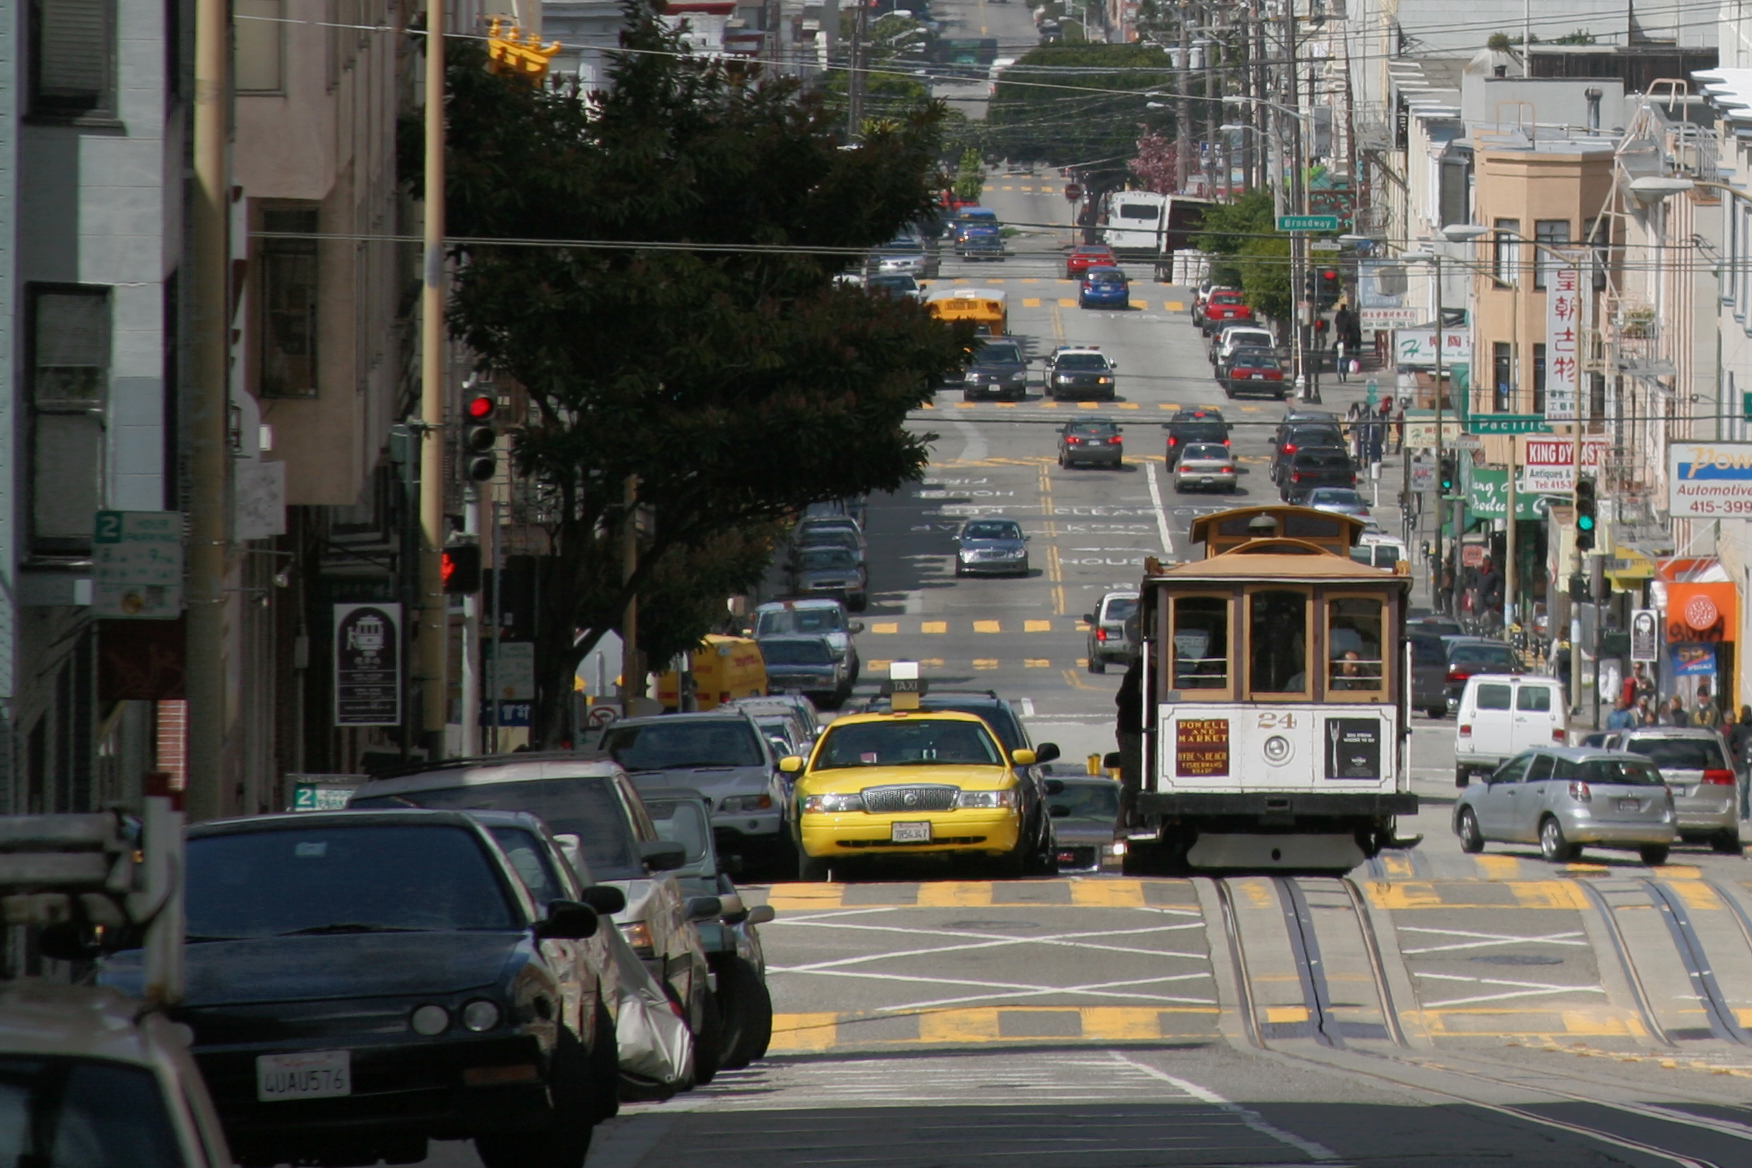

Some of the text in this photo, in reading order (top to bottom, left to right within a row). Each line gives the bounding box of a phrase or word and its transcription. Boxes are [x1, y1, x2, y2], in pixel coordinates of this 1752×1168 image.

[1284, 218, 1331, 229] Broadway
[1479, 419, 1546, 431] Pacific
[1529, 444, 1556, 463] KING
[1529, 468, 1564, 480] Antiques
[101, 516, 120, 538] 2
[894, 681, 918, 691] TAXI
[1179, 721, 1227, 729] POWELL
[1257, 712, 1298, 729] 24
[1178, 735, 1227, 743] MARKET
[298, 788, 312, 805] 2
[264, 1068, 344, 1094] 4UAU576
